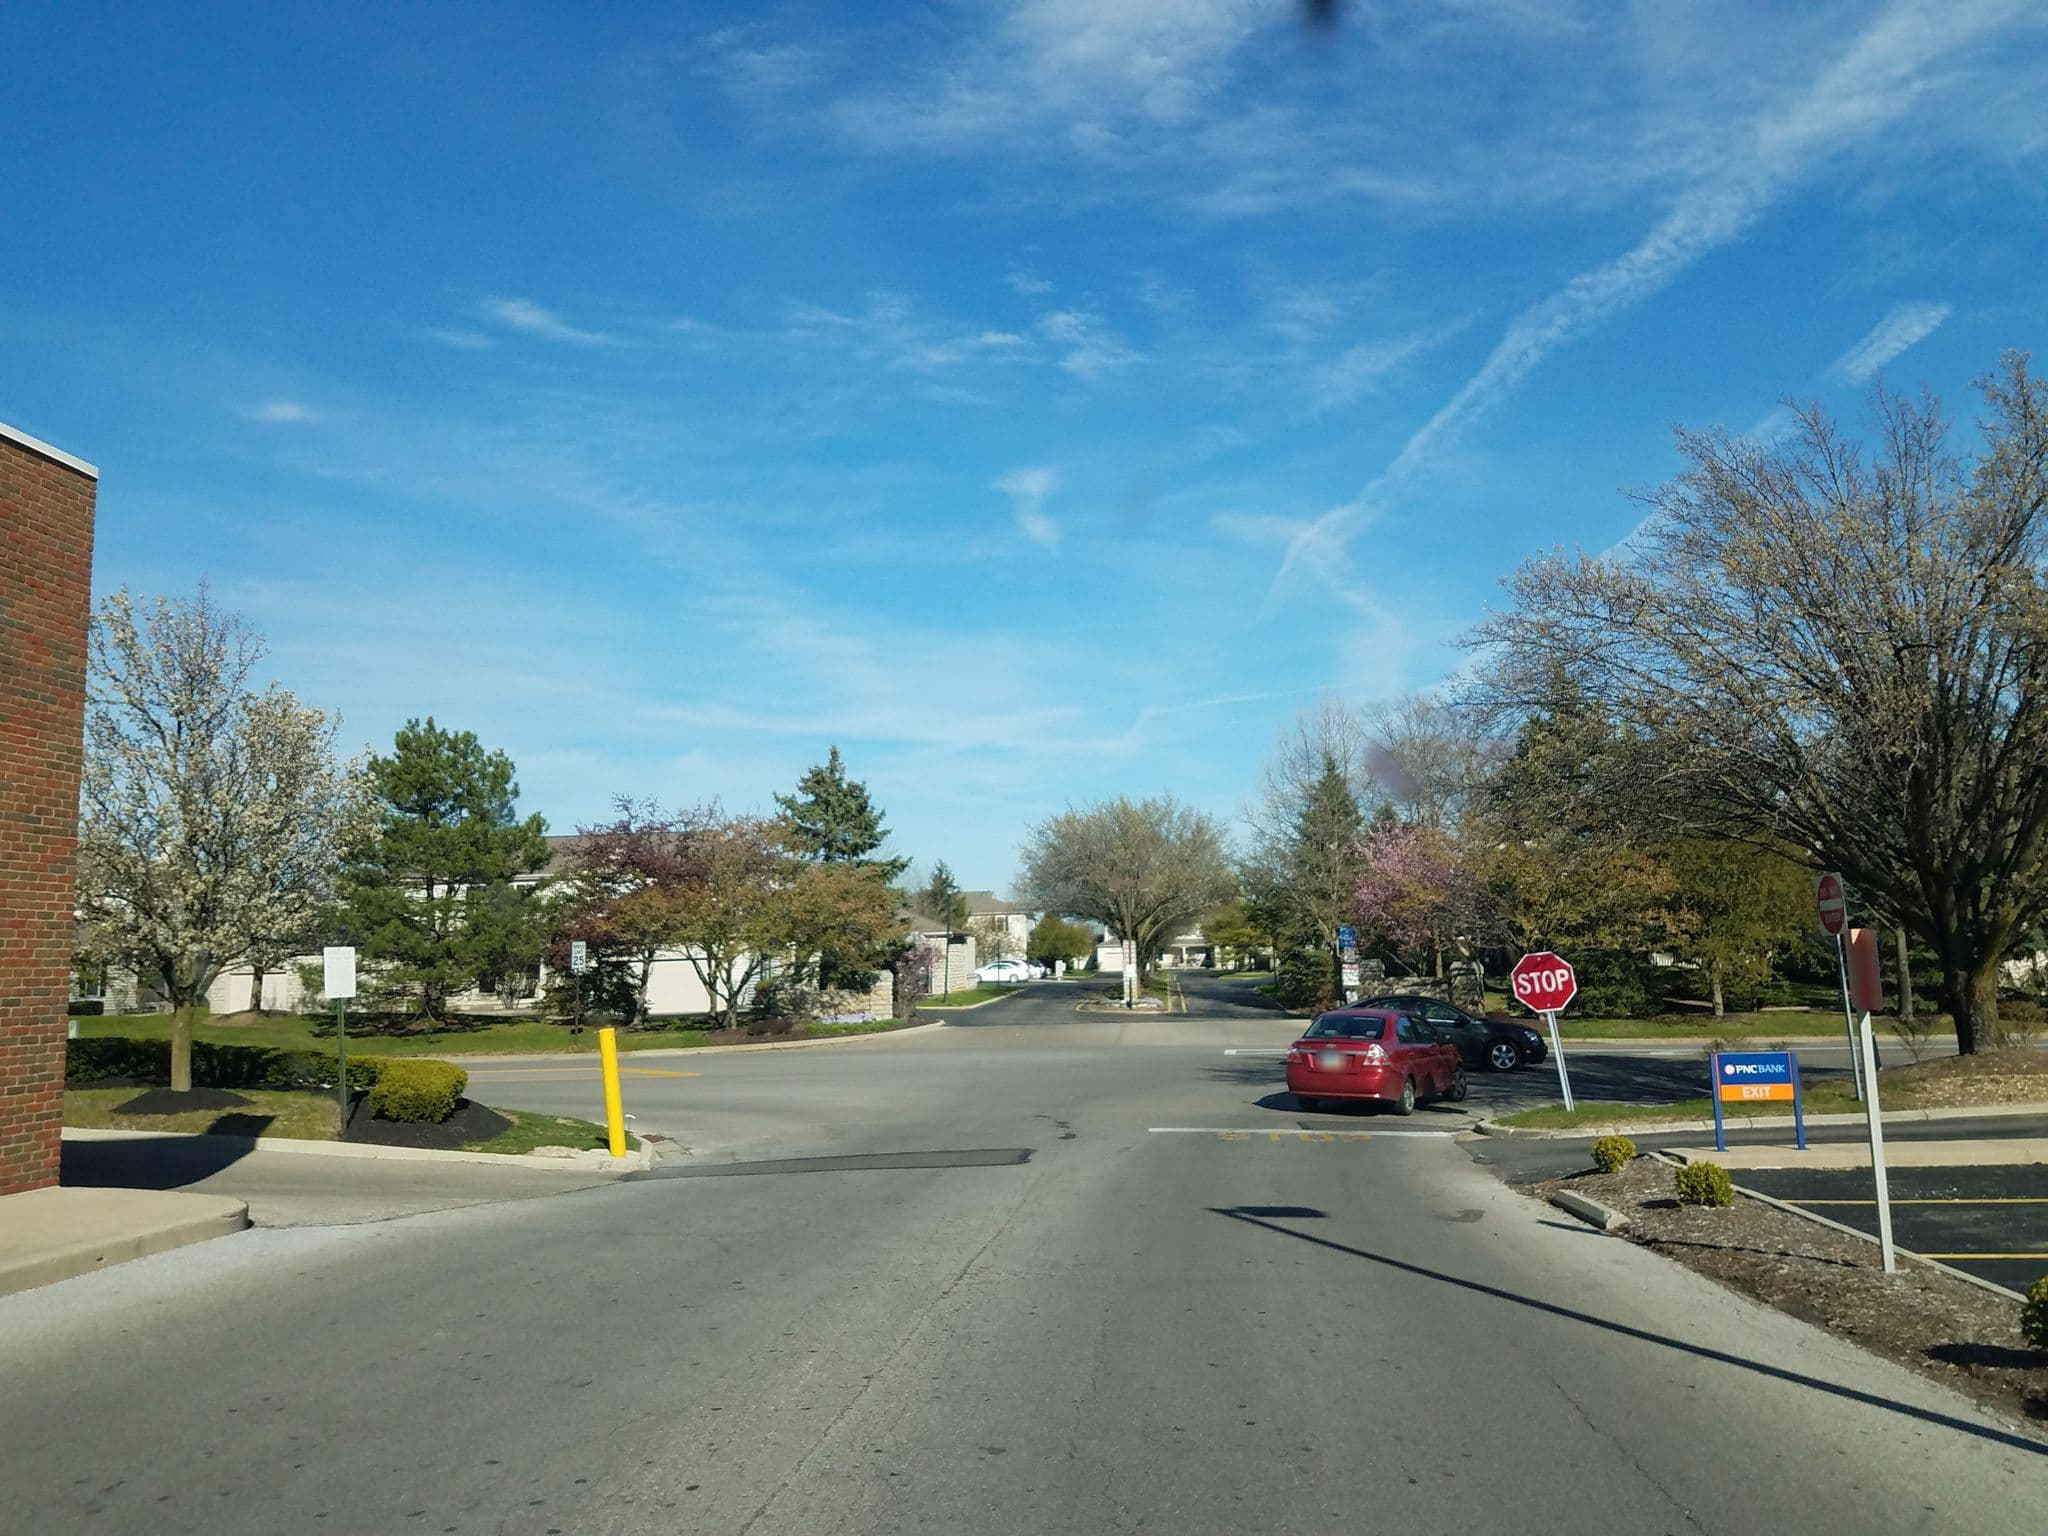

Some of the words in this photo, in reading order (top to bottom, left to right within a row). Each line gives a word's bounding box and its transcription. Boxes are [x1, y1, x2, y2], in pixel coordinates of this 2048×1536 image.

[573, 955, 585, 966] 25
[1517, 968, 1570, 995] STOP
[1742, 1086, 1772, 1099] EXIT
